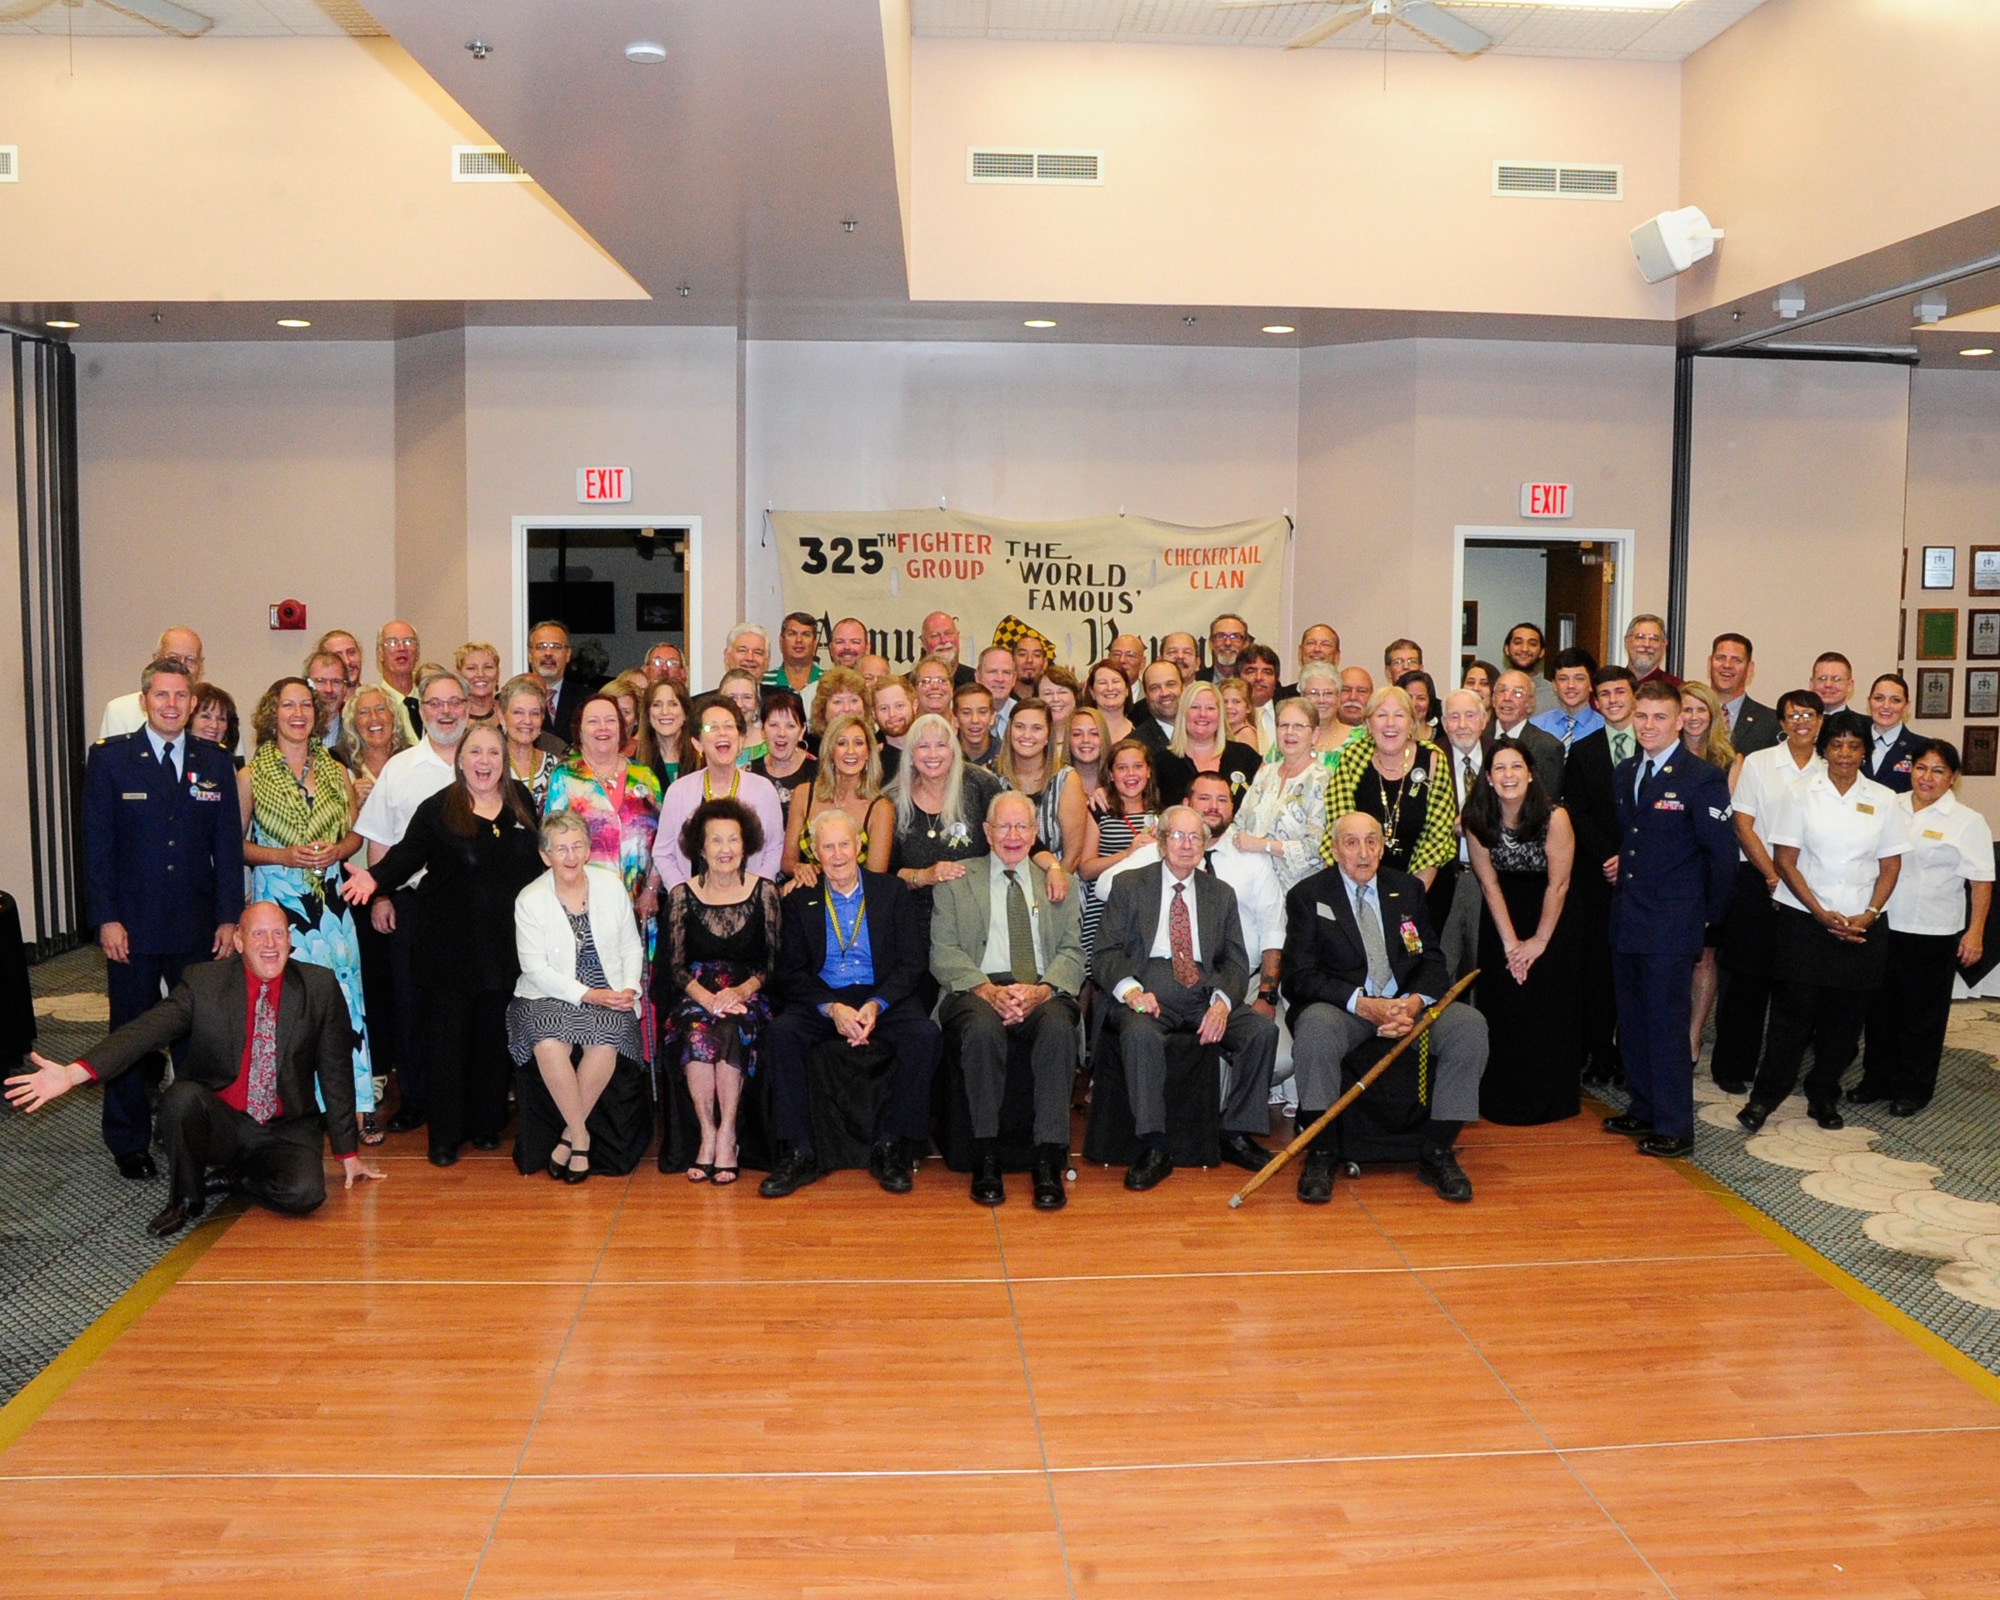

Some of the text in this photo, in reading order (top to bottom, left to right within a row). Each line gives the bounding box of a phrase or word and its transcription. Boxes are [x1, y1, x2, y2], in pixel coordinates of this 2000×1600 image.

[585, 468, 624, 499] EXIT
[1530, 484, 1568, 514] EXIT
[897, 532, 992, 555] FIGHTER
[1005, 540, 1072, 559] THE
[1163, 545, 1262, 567] CHECKERTAIL
[906, 558, 985, 581] GROUP
[1189, 569, 1244, 590] CLAN
